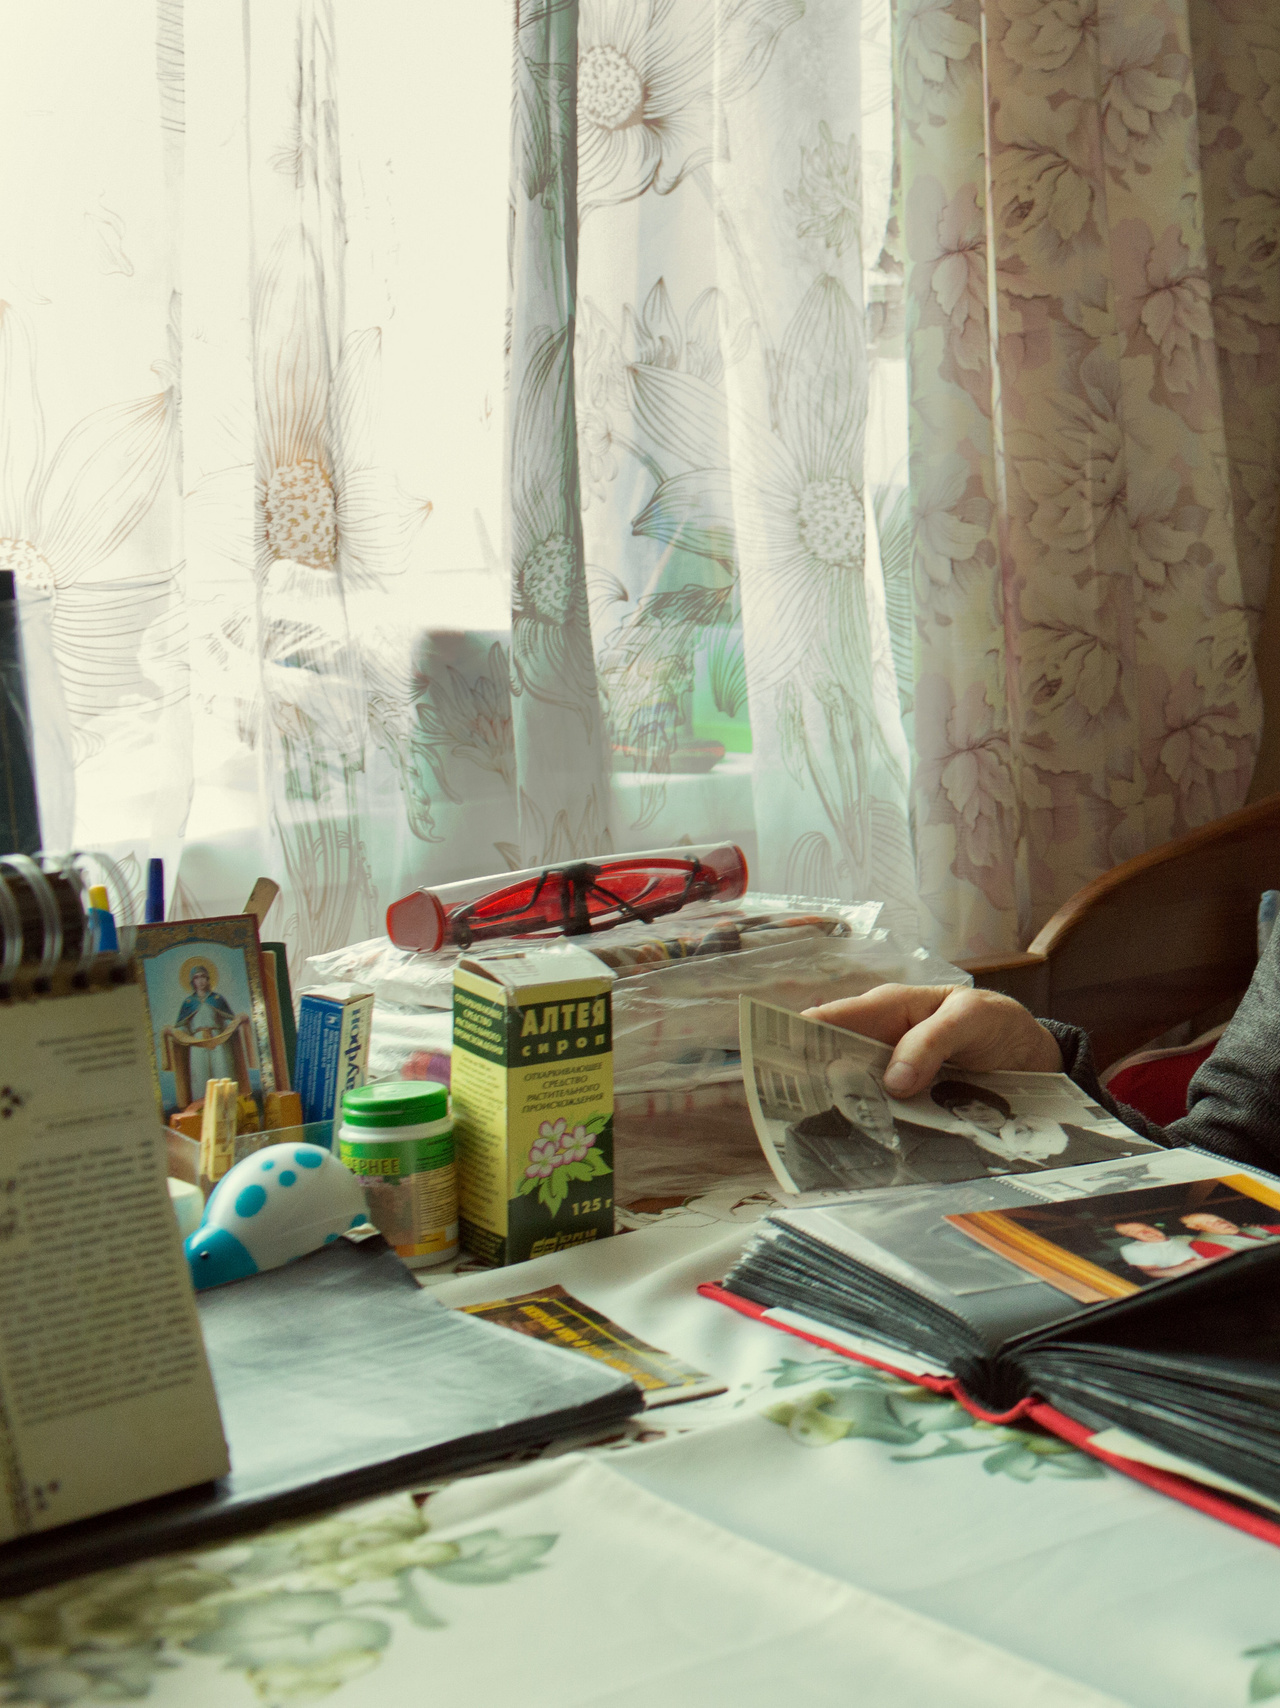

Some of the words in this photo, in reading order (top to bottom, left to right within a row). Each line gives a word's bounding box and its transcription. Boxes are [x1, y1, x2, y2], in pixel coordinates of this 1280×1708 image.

[521, 998, 606, 1037] АЛТЕЯ
[521, 1034, 605, 1057] сироп
[542, 1075, 588, 1090] СРЕДСТВО
[572, 1198, 602, 1216] 125
